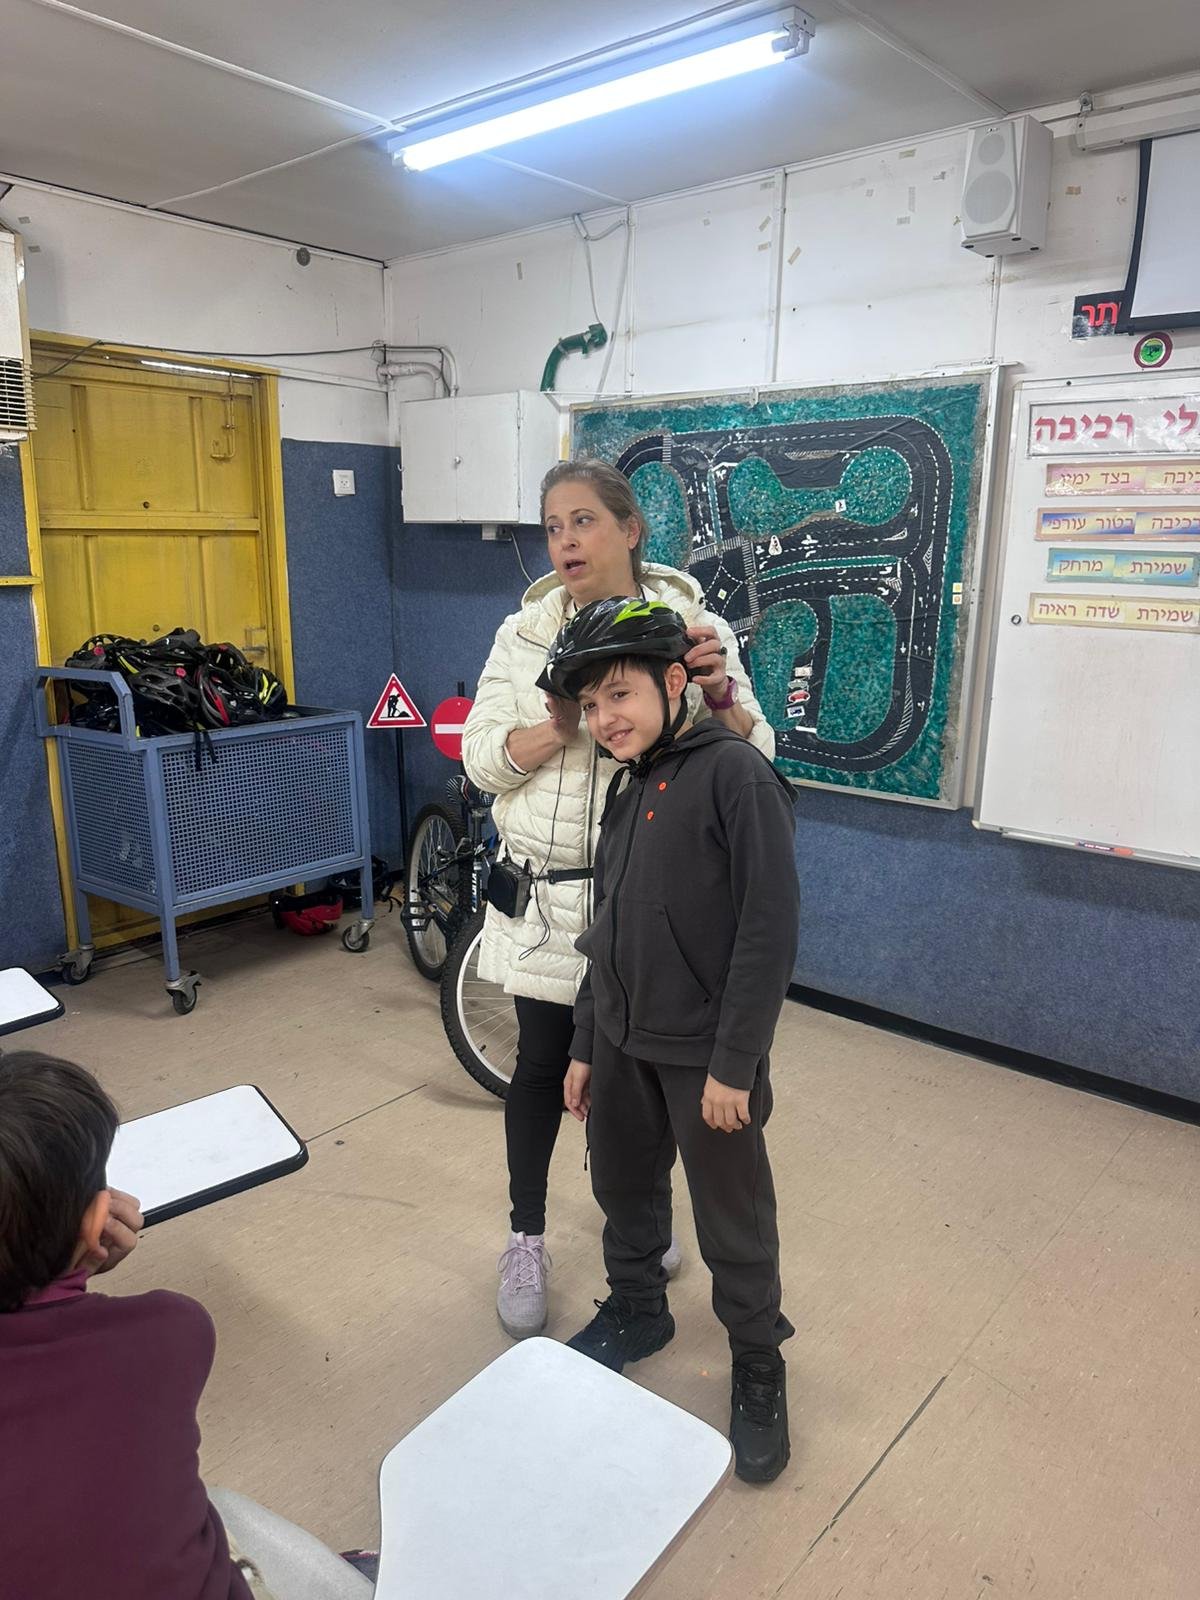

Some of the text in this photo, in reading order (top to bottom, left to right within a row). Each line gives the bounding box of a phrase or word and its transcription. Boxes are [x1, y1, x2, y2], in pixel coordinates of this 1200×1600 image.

[1081, 302, 1121, 327] תר
[1034, 413, 1134, 443] רכיבה
[1060, 472, 1091, 487] ימין
[1100, 471, 1131, 485] בצד
[1047, 517, 1087, 531] עורפי
[1058, 559, 1187, 576] שמירת מרחק
[1038, 603, 1194, 623] שמירת שדה ראיה
